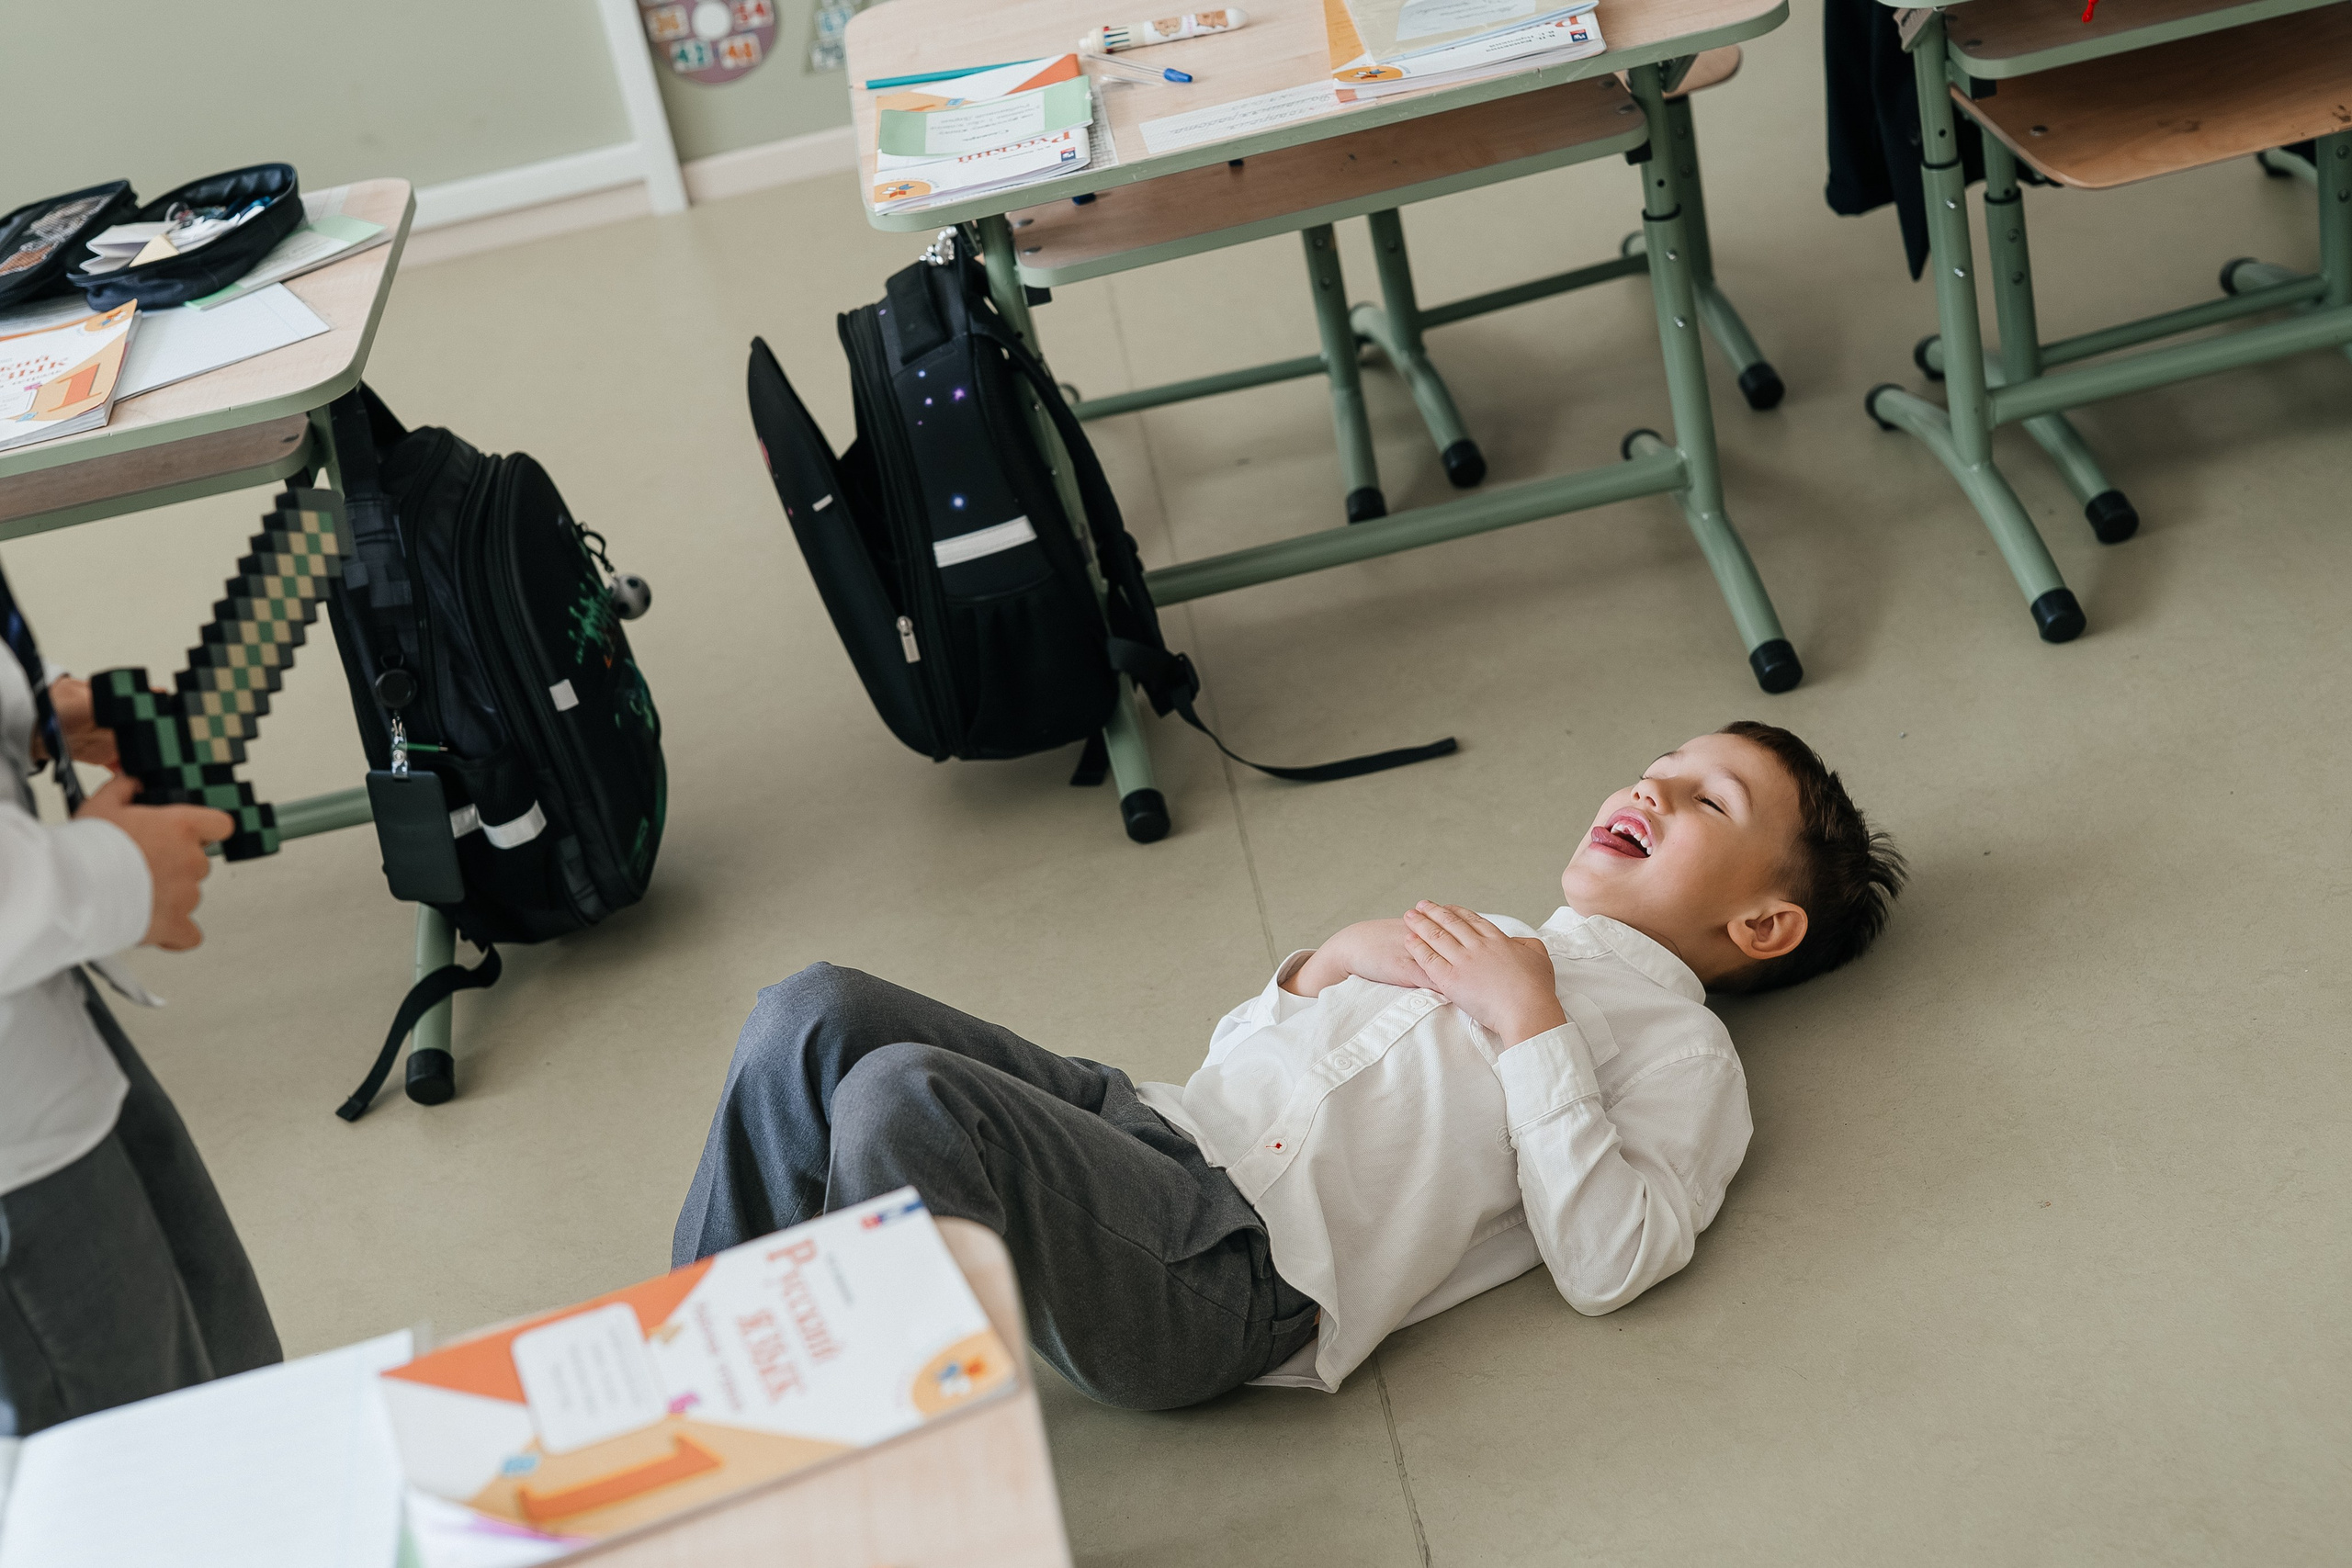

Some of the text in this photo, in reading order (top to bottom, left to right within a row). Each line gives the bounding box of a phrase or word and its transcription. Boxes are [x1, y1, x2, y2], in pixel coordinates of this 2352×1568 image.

[958, 131, 1070, 164] Русский
[47, 362, 102, 412] 1
[764, 1236, 842, 1364] Русский
[517, 1431, 723, 1525] 1
